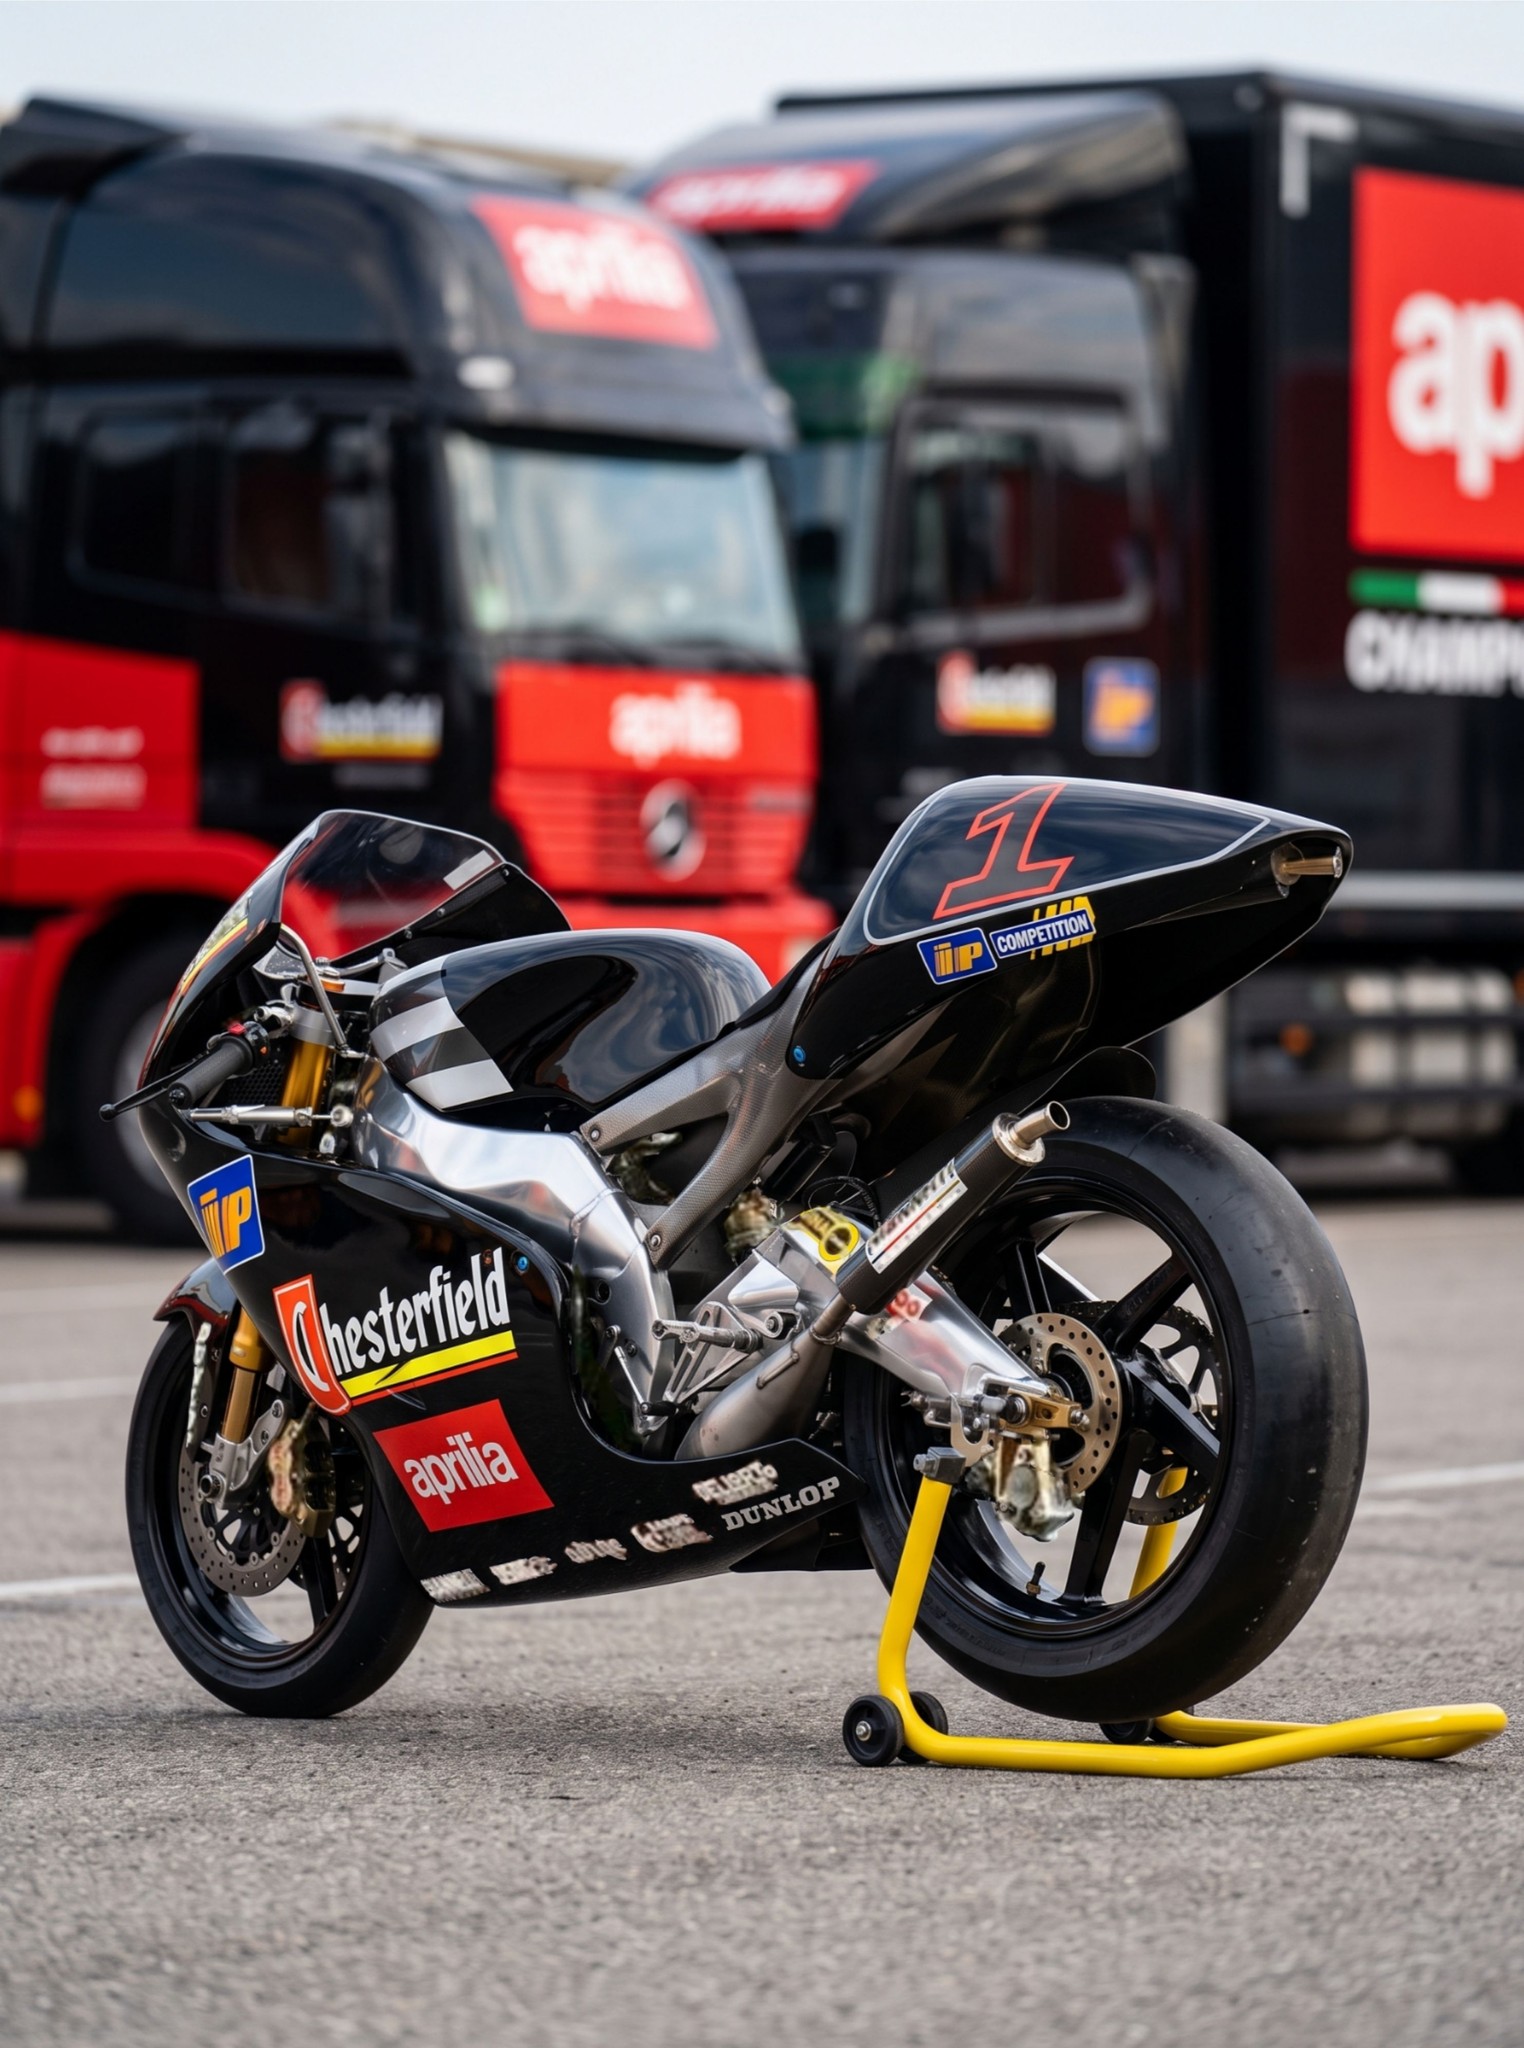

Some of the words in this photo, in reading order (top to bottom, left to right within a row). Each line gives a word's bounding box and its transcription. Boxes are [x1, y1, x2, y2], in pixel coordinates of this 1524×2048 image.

[933, 782, 1075, 920] 1
[996, 912, 1090, 954] COMPETITION
[292, 1246, 510, 1392] Chesterfield
[403, 1431, 519, 1505] aprilia
[721, 1476, 840, 1531] DUNLOP
